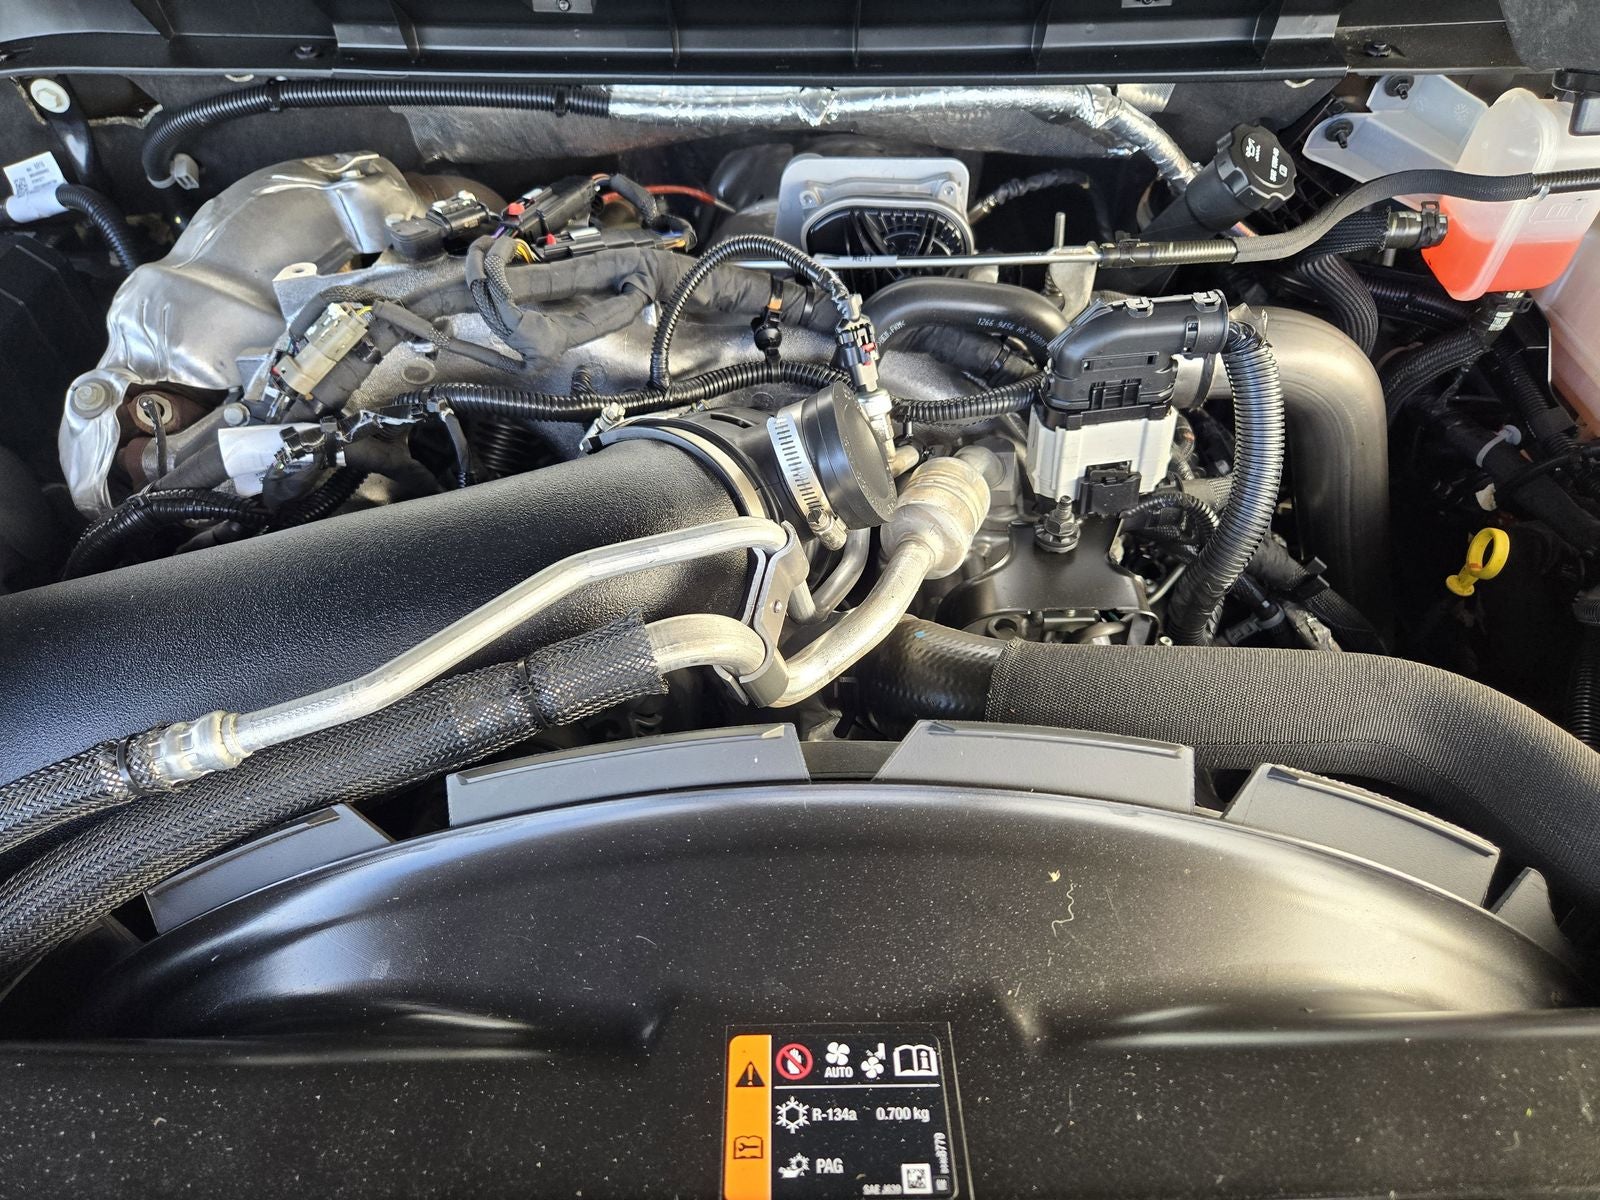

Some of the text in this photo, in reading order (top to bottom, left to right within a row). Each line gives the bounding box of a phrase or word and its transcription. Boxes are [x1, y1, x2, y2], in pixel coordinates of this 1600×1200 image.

[824, 1066, 854, 1078] AUTO
[812, 1106, 930, 1123] R-134a 0.700 kg
[815, 1158, 845, 1174] PAG
